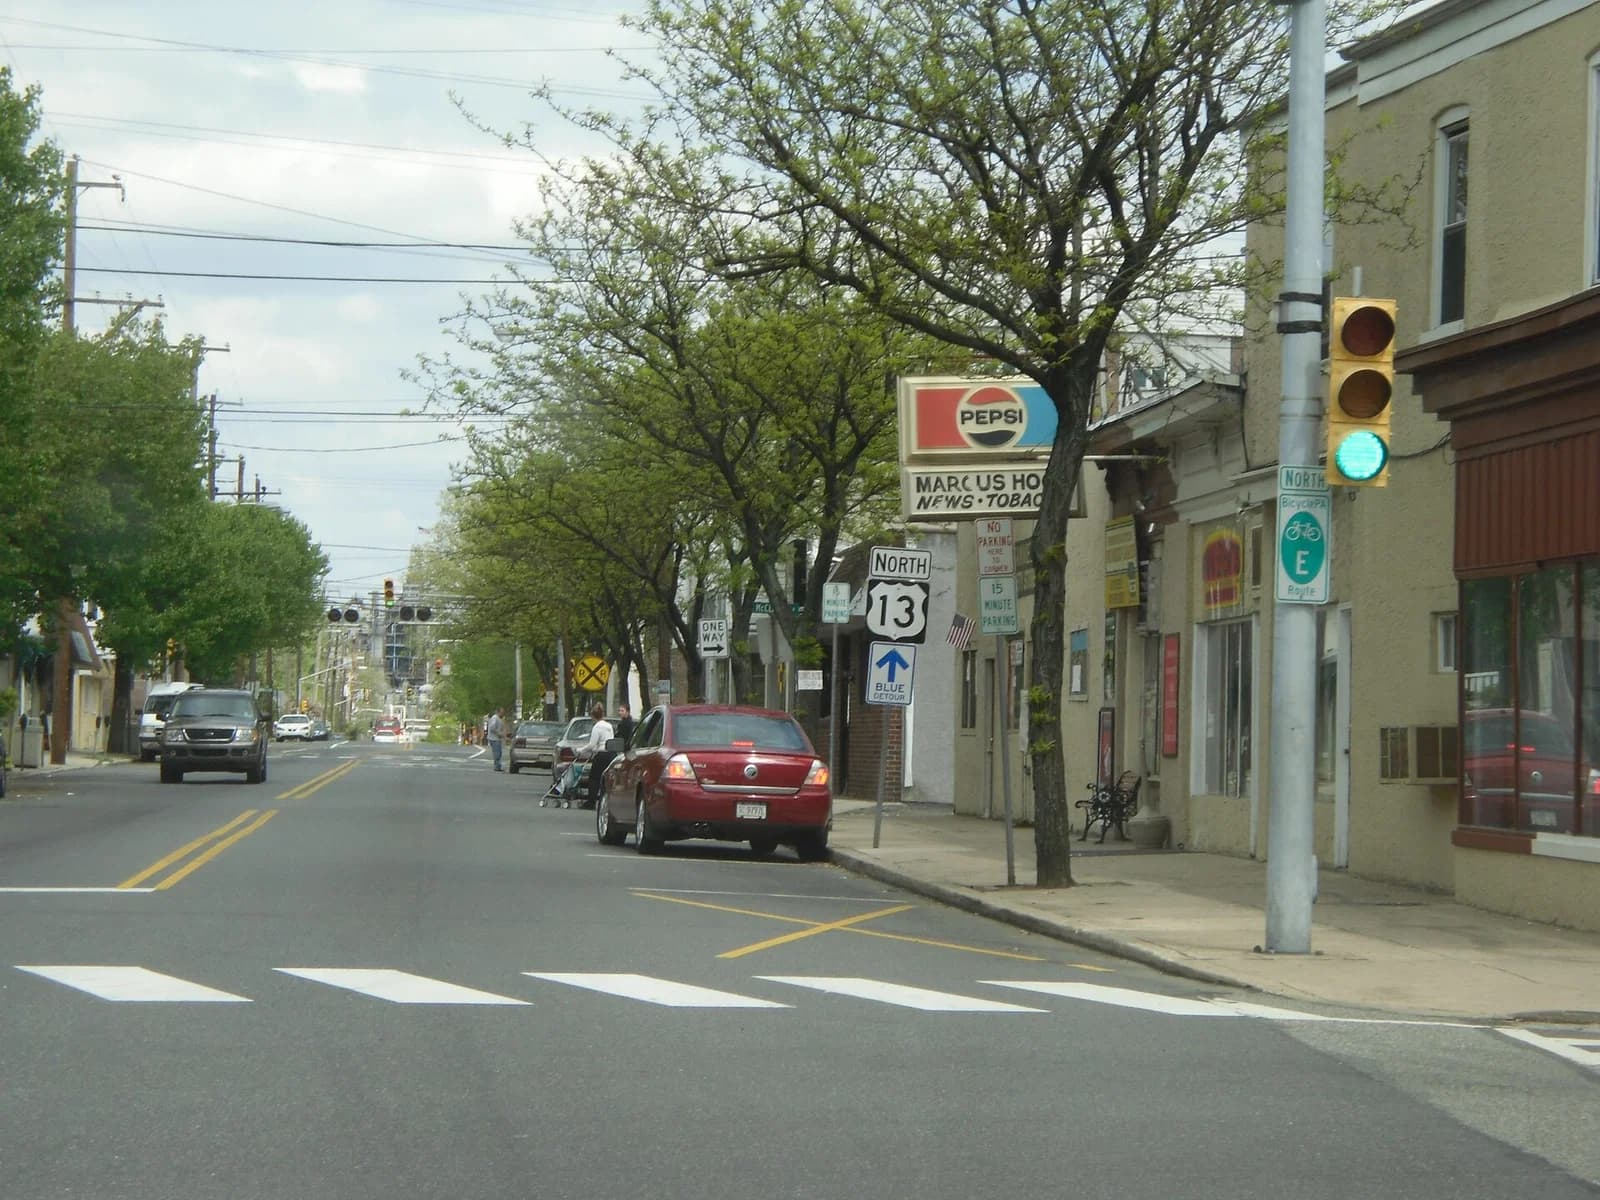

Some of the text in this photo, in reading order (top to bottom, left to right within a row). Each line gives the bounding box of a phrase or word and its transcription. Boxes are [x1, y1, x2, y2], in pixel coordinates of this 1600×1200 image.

[960, 408, 1023, 425] PEPSI
[916, 474, 1006, 492] MARCUS
[1285, 470, 1325, 488] NORTH
[917, 492, 1043, 510] NEWS TOBAC
[986, 521, 1001, 533] NO
[977, 535, 1012, 546] PARKING
[875, 553, 927, 574] NORTH
[1295, 550, 1310, 575] E
[992, 583, 1003, 594] 15
[984, 599, 1012, 610] MINUTE
[879, 595, 915, 628] 13
[983, 615, 1015, 626] PARKING
[702, 622, 724, 632] ONE
[702, 633, 725, 643] WAY
[579, 669, 607, 677] R R
[875, 682, 905, 693] BLUE
[873, 692, 905, 701] DETOUR
